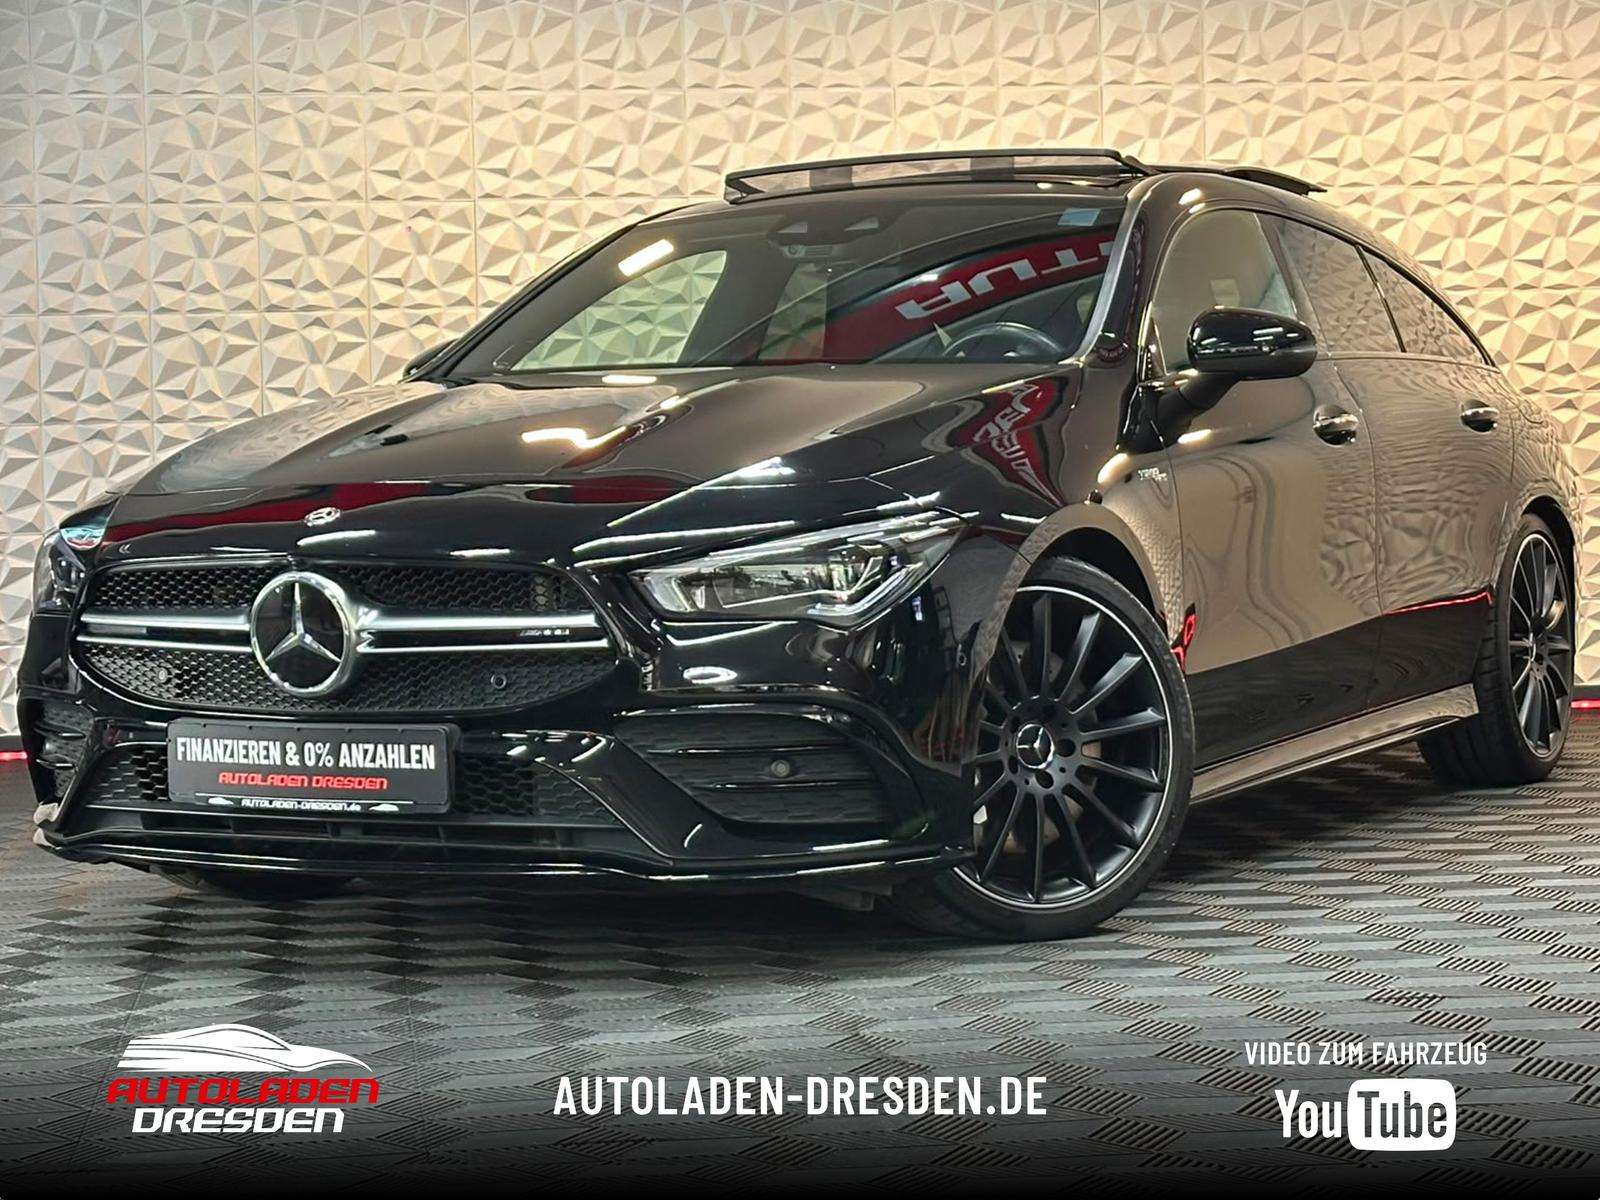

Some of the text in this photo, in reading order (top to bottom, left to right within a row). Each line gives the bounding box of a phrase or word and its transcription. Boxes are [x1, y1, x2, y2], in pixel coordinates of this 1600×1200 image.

[176, 736, 436, 770] FINANZIEREN & 0% ANZAHLEN
[218, 771, 389, 790] AUTOLADEN DRESDEN
